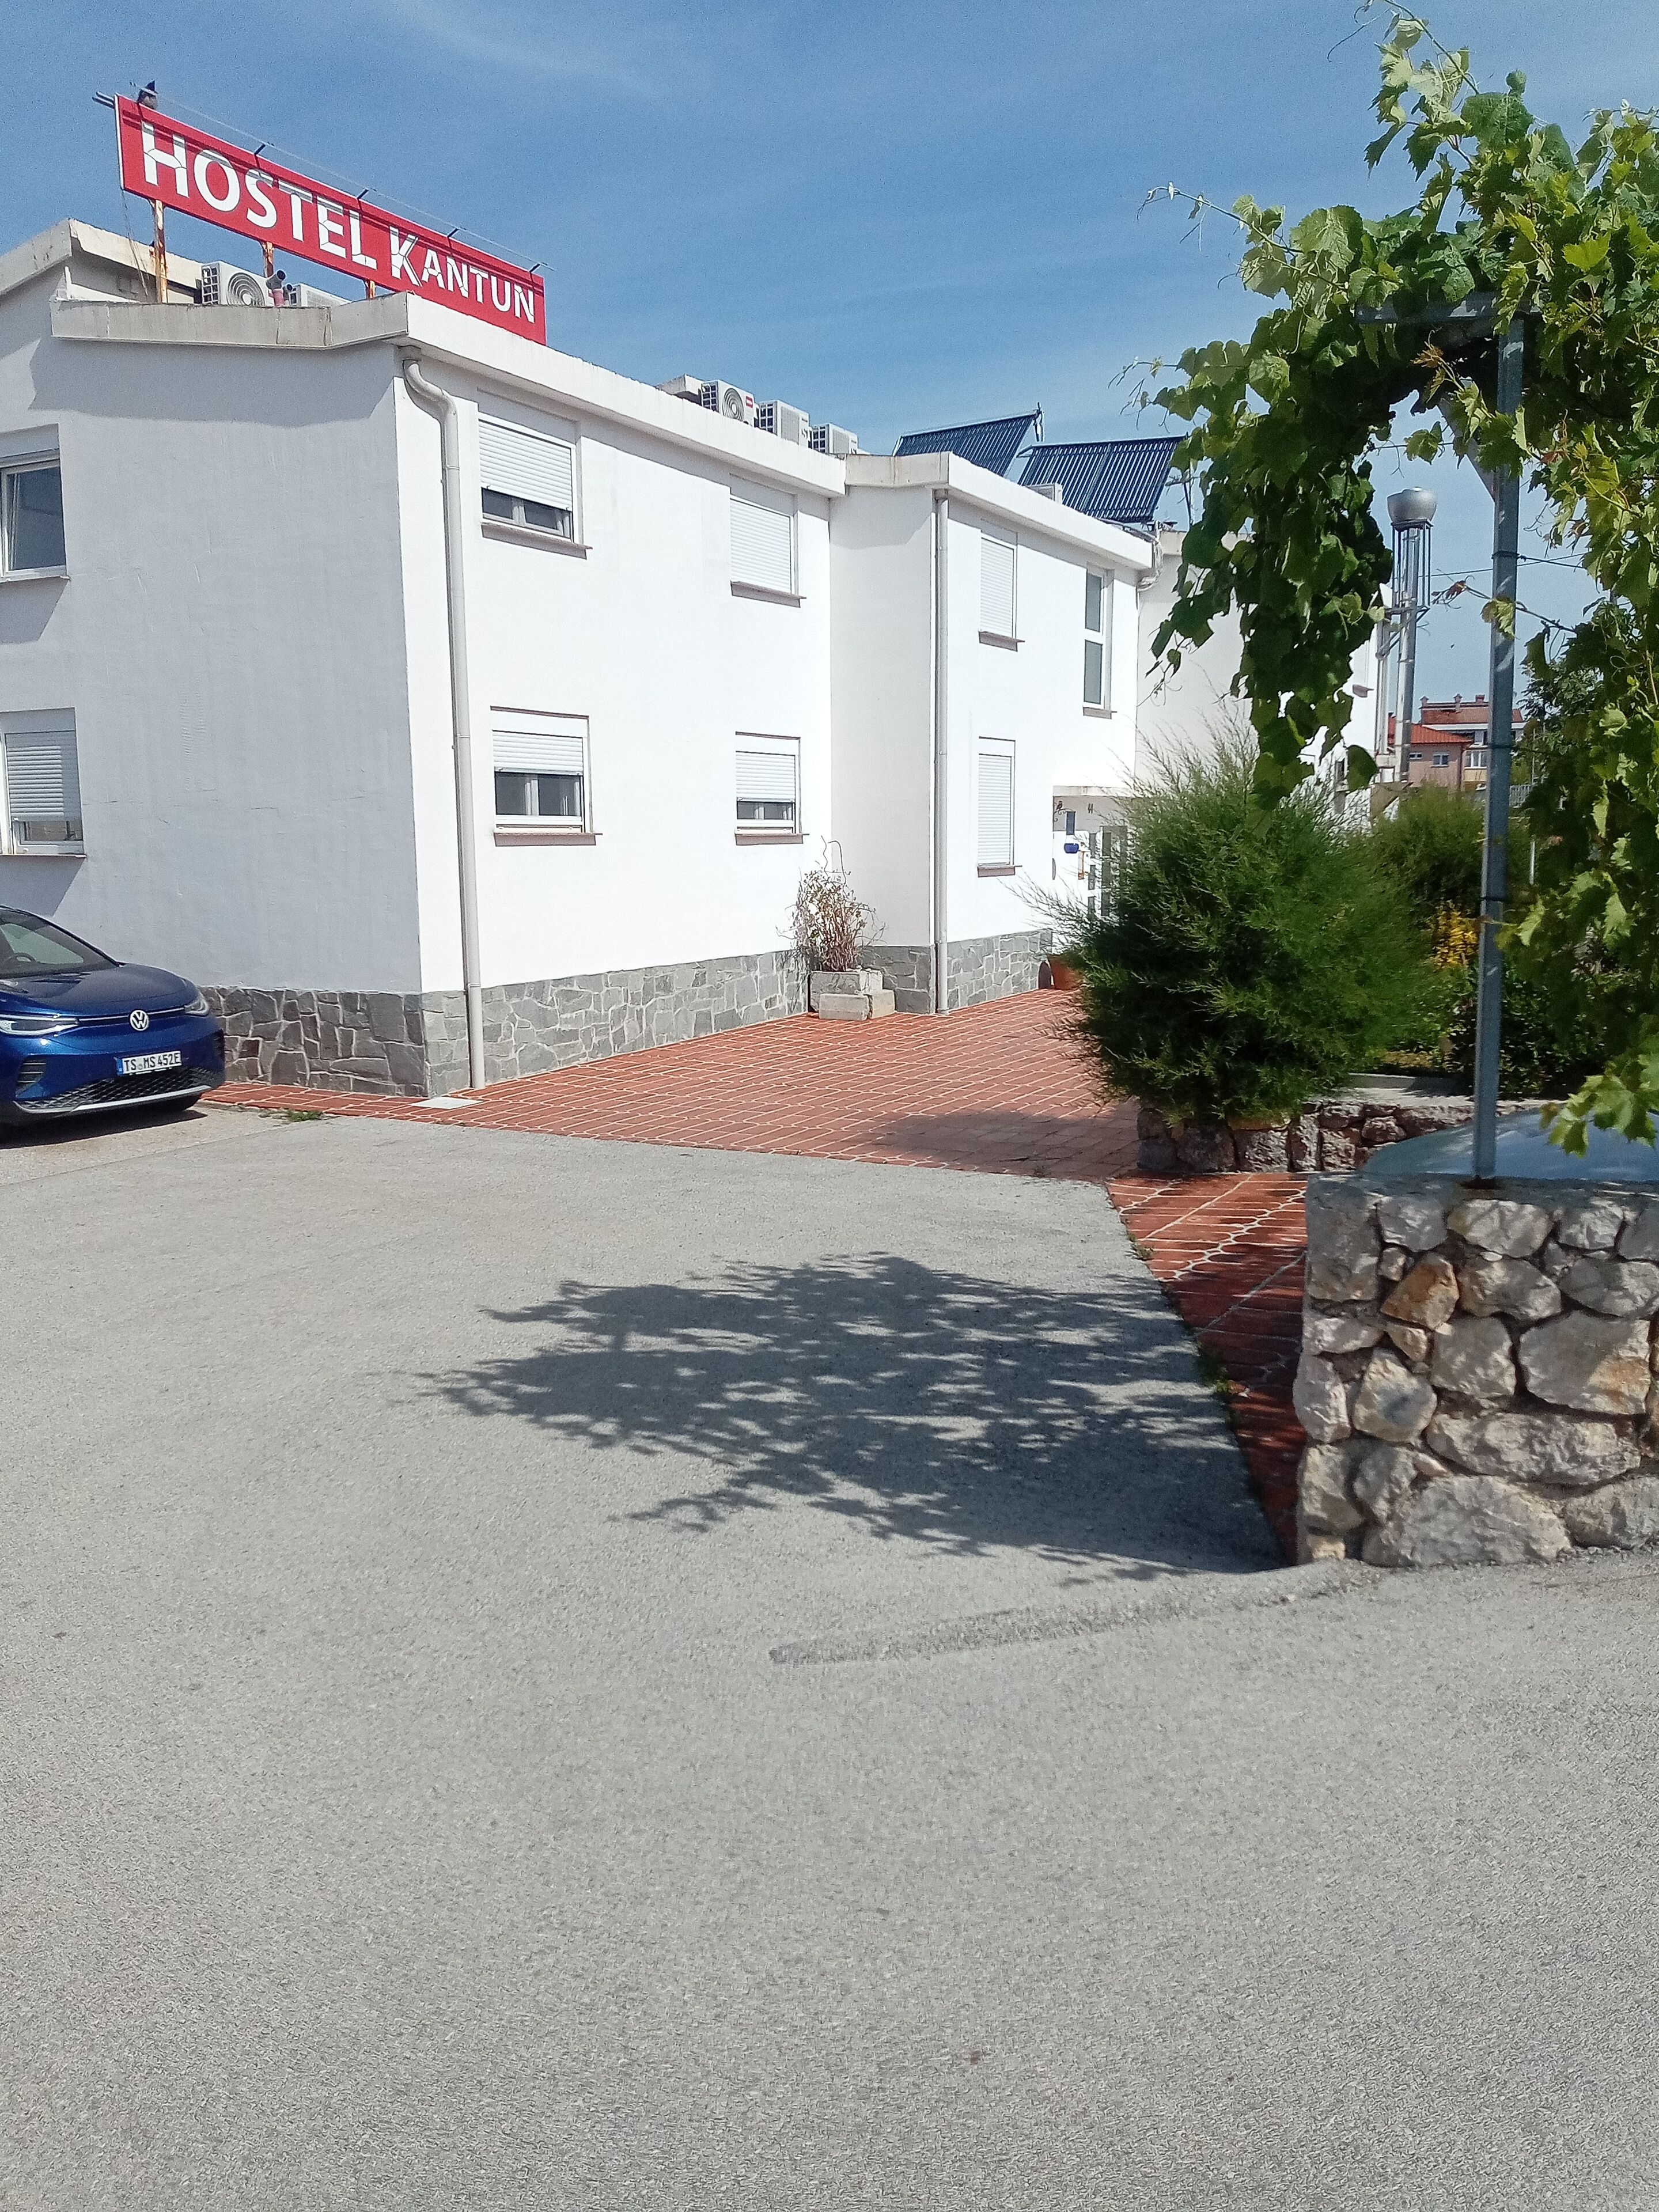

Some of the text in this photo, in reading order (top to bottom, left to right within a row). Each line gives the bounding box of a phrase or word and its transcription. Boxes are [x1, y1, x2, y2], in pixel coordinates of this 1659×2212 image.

[141, 120, 535, 324] HOSTEL KANTUN
[123, 1059, 137, 1071] TS
